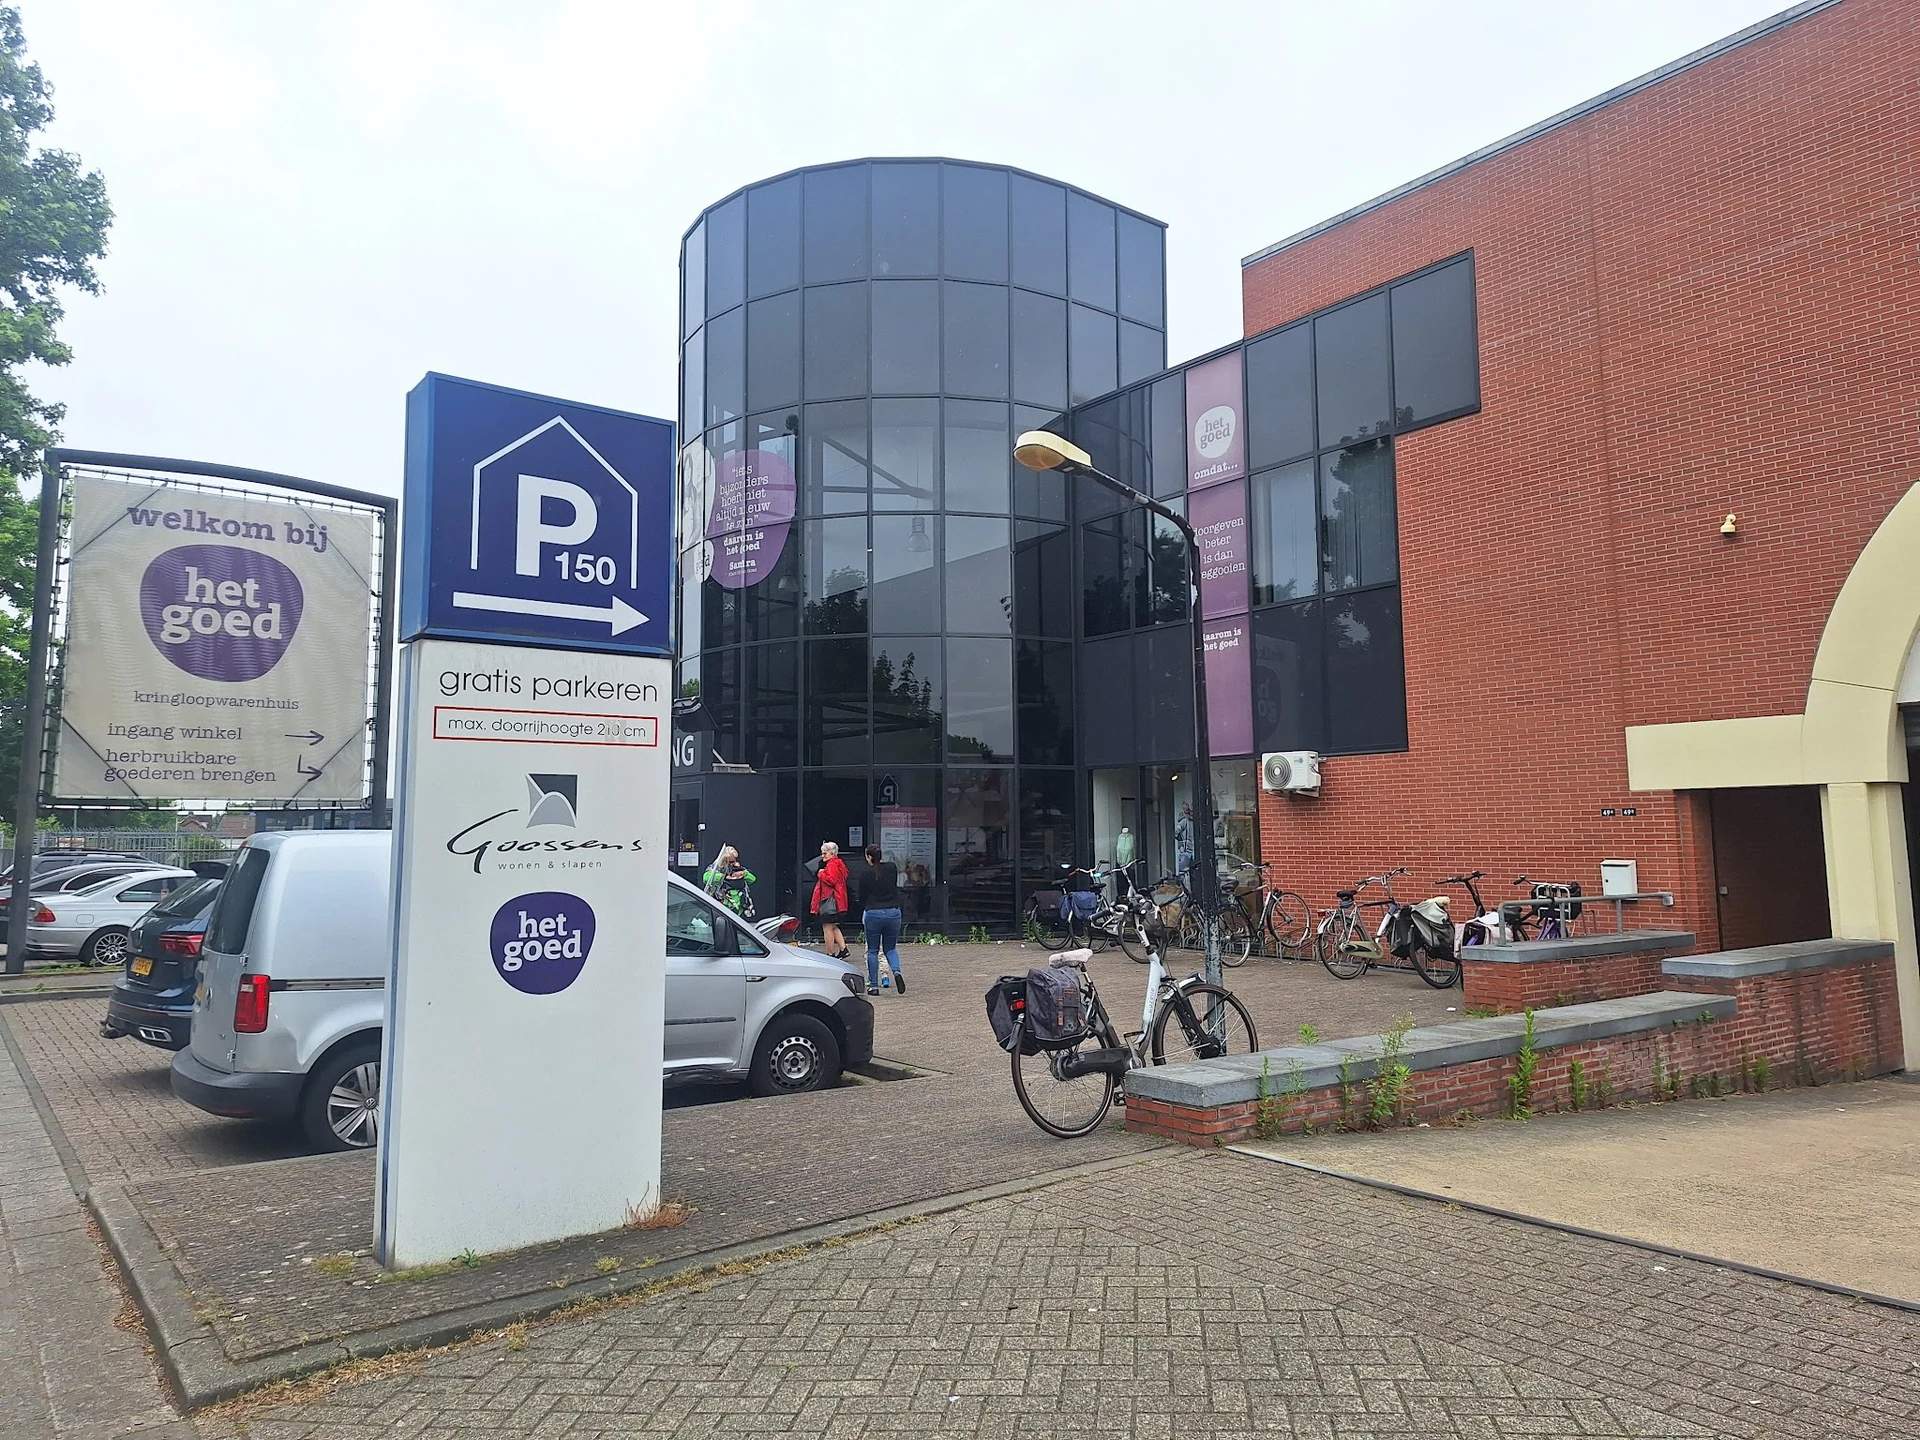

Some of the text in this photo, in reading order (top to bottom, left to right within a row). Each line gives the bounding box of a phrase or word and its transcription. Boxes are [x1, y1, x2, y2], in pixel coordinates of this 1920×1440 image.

[1205, 416, 1224, 433] het
[1200, 422, 1231, 449] goed
[1194, 461, 1238, 480] omdat...
[127, 506, 329, 553] welkom bij
[515, 473, 598, 577] P
[754, 530, 764, 540] is
[1204, 535, 1232, 549] beter
[1203, 549, 1234, 564] is dan
[555, 551, 617, 586] 150
[1201, 562, 1246, 580] eggooien
[184, 566, 260, 609] het
[160, 602, 283, 645] goed
[1233, 627, 1242, 636] is
[1218, 637, 1239, 651] goed
[439, 669, 659, 702] gratis parkeren
[133, 690, 300, 711] kringloopwarenhuis
[107, 722, 243, 742] ingang winkel
[448, 716, 487, 731] max.
[491, 718, 594, 738] doorrijhoogte
[623, 727, 646, 738] cm
[104, 748, 237, 766] herbruikbare
[103, 765, 277, 785] goederen brengen
[446, 808, 643, 875] Goossens
[498, 859, 602, 870] wonen & slapen
[518, 910, 568, 939] het
[502, 929, 582, 972] goed
